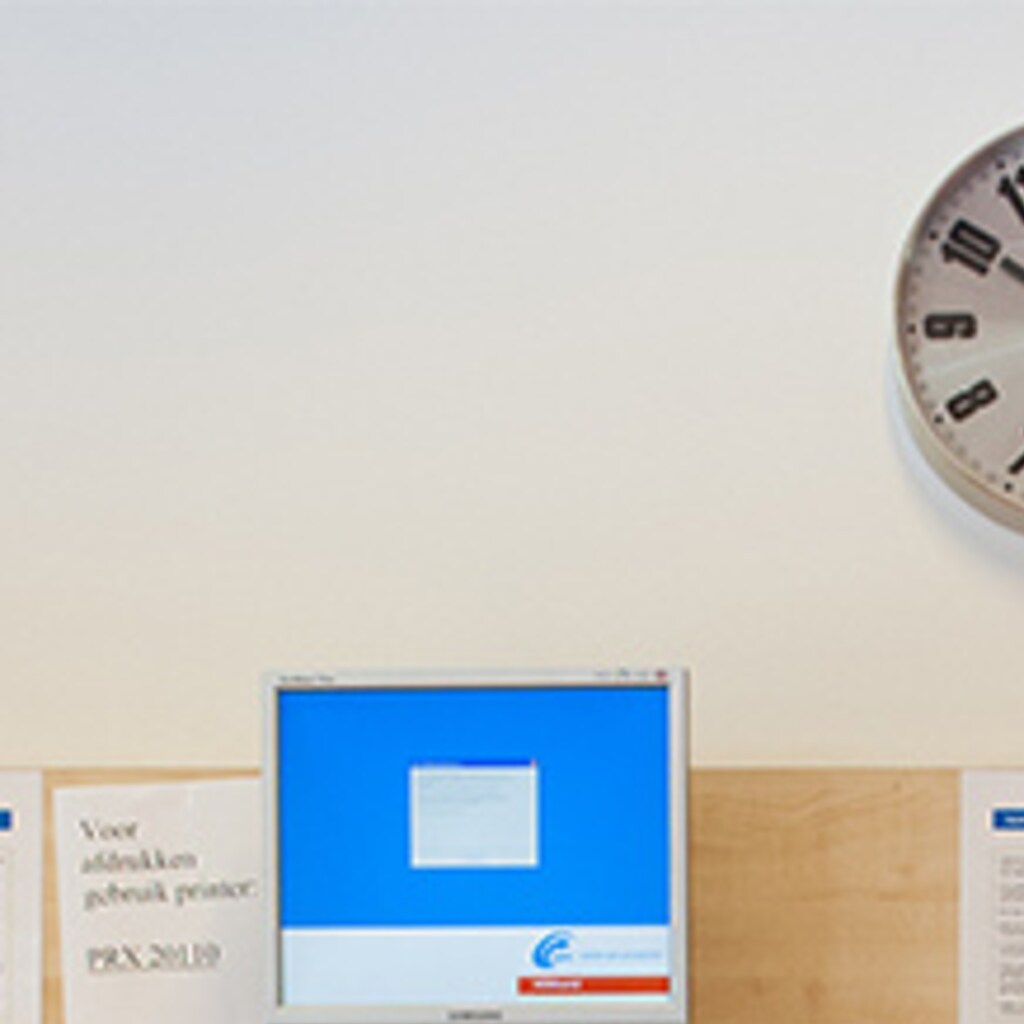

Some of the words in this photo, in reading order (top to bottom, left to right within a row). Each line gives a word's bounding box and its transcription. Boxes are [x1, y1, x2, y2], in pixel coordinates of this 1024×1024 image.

[941, 220, 1002, 275] 10
[924, 312, 977, 339] 9
[945, 378, 998, 422] 8
[80, 819, 138, 840] Voor
[81, 849, 198, 875] afdrukken
[84, 880, 169, 911] gebruik
